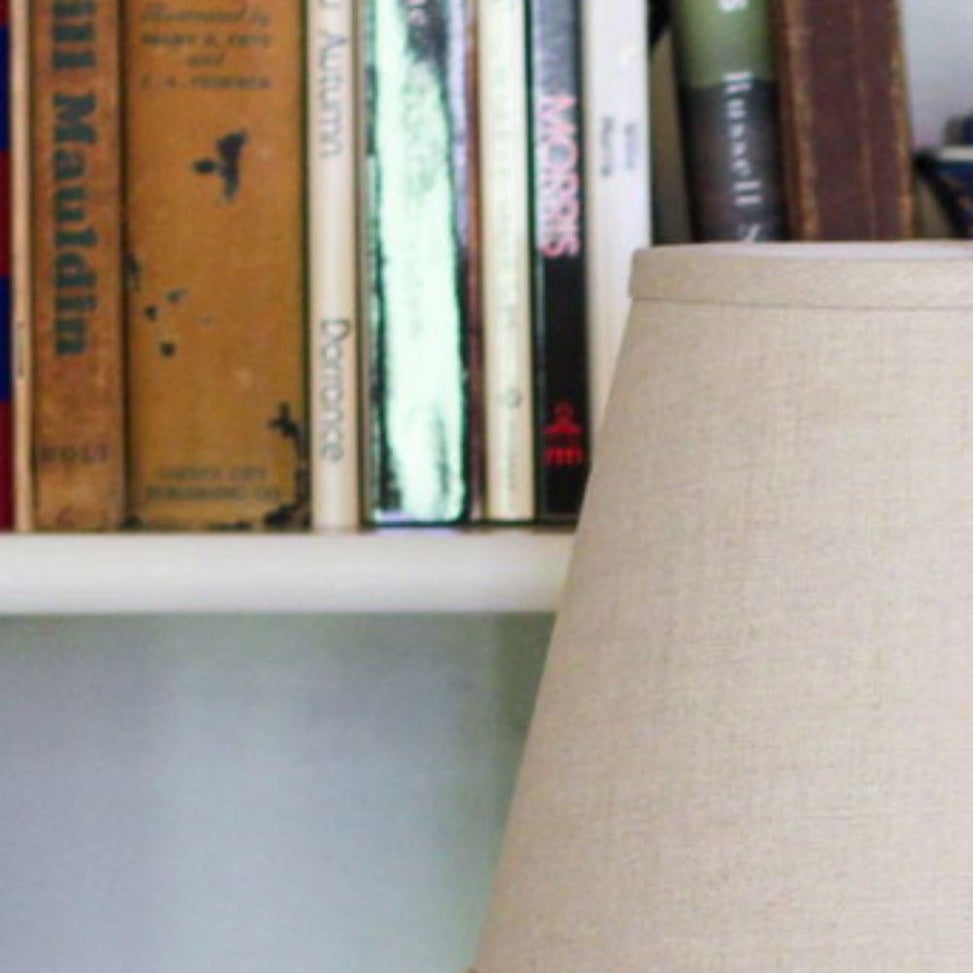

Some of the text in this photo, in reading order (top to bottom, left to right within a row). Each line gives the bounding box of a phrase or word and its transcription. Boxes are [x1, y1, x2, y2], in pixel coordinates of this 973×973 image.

[318, 33, 348, 159] Autumn
[538, 95, 580, 258] MORRIS
[52, 94, 96, 356] Mauldin
